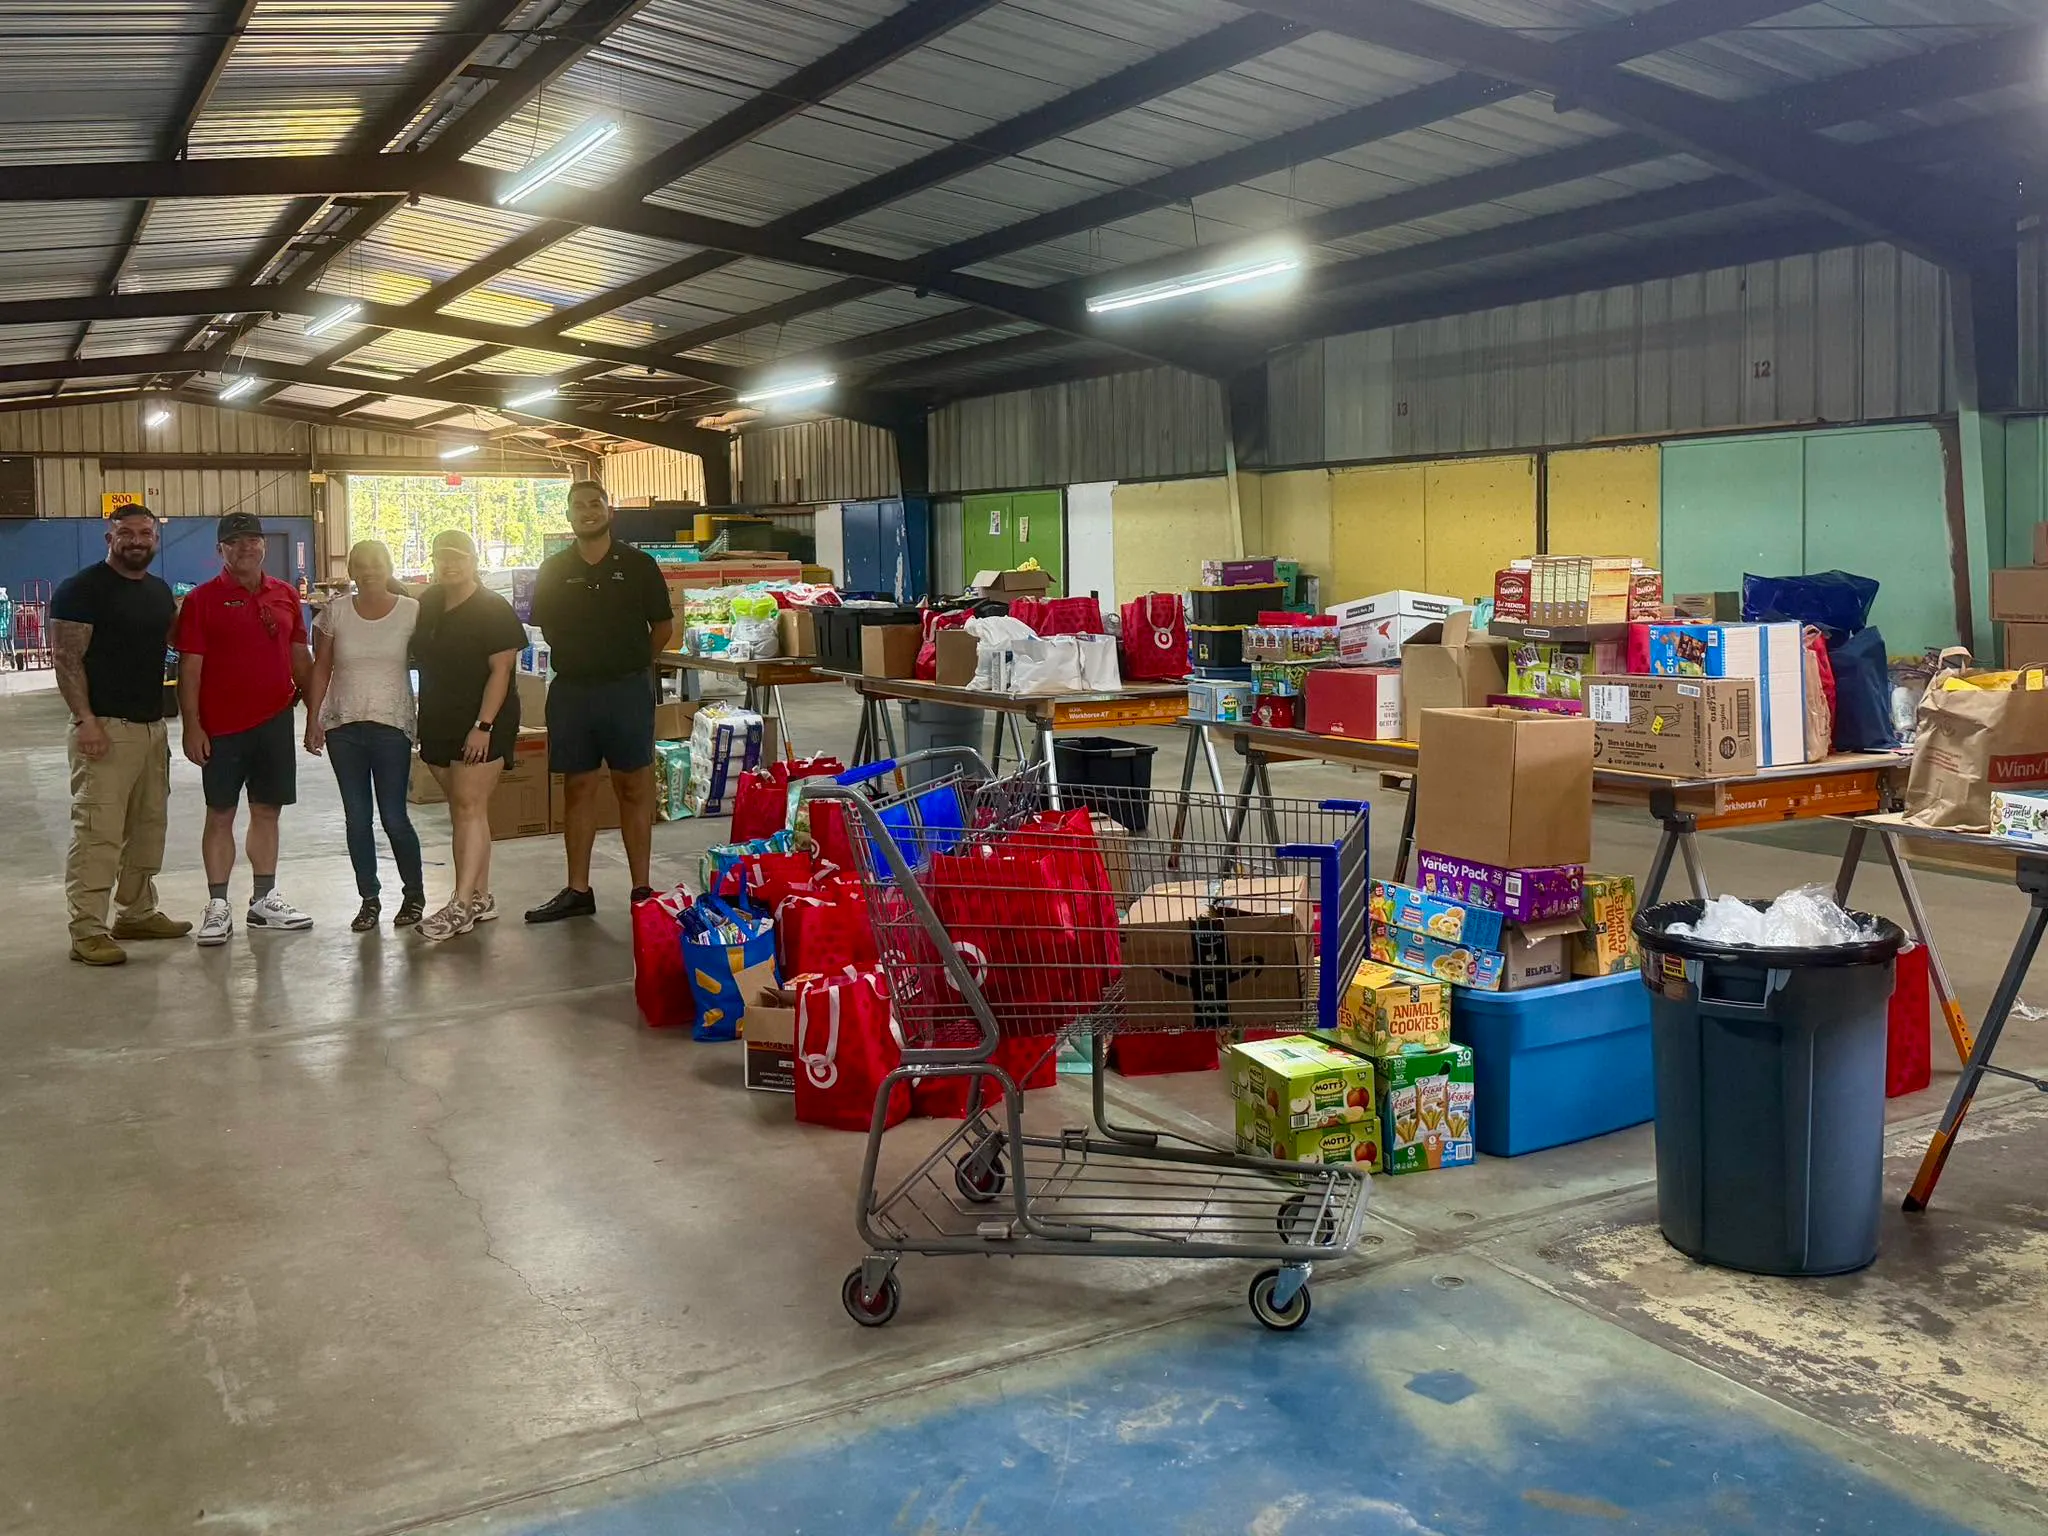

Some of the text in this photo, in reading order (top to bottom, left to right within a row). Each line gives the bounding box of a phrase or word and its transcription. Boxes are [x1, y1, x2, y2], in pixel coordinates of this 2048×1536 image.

[1752, 359, 1771, 379] 12
[1396, 401, 1409, 417] 13
[111, 494, 132, 504] 800
[1640, 690, 1651, 698] CUT
[1723, 800, 1756, 812] orkhorse
[2003, 806, 2032, 818] Beneful
[1422, 856, 1488, 882] Variety Pack
[1605, 901, 1617, 952] ANIMAL
[1615, 895, 1627, 954] COOKIES
[1393, 1002, 1437, 1020] ANIMAL
[1389, 1017, 1439, 1035] COOKIES
[1457, 1050, 1471, 1062] 30
[1314, 1081, 1344, 1092] MOTT'S
[1322, 1136, 1351, 1147] MOTT'S
